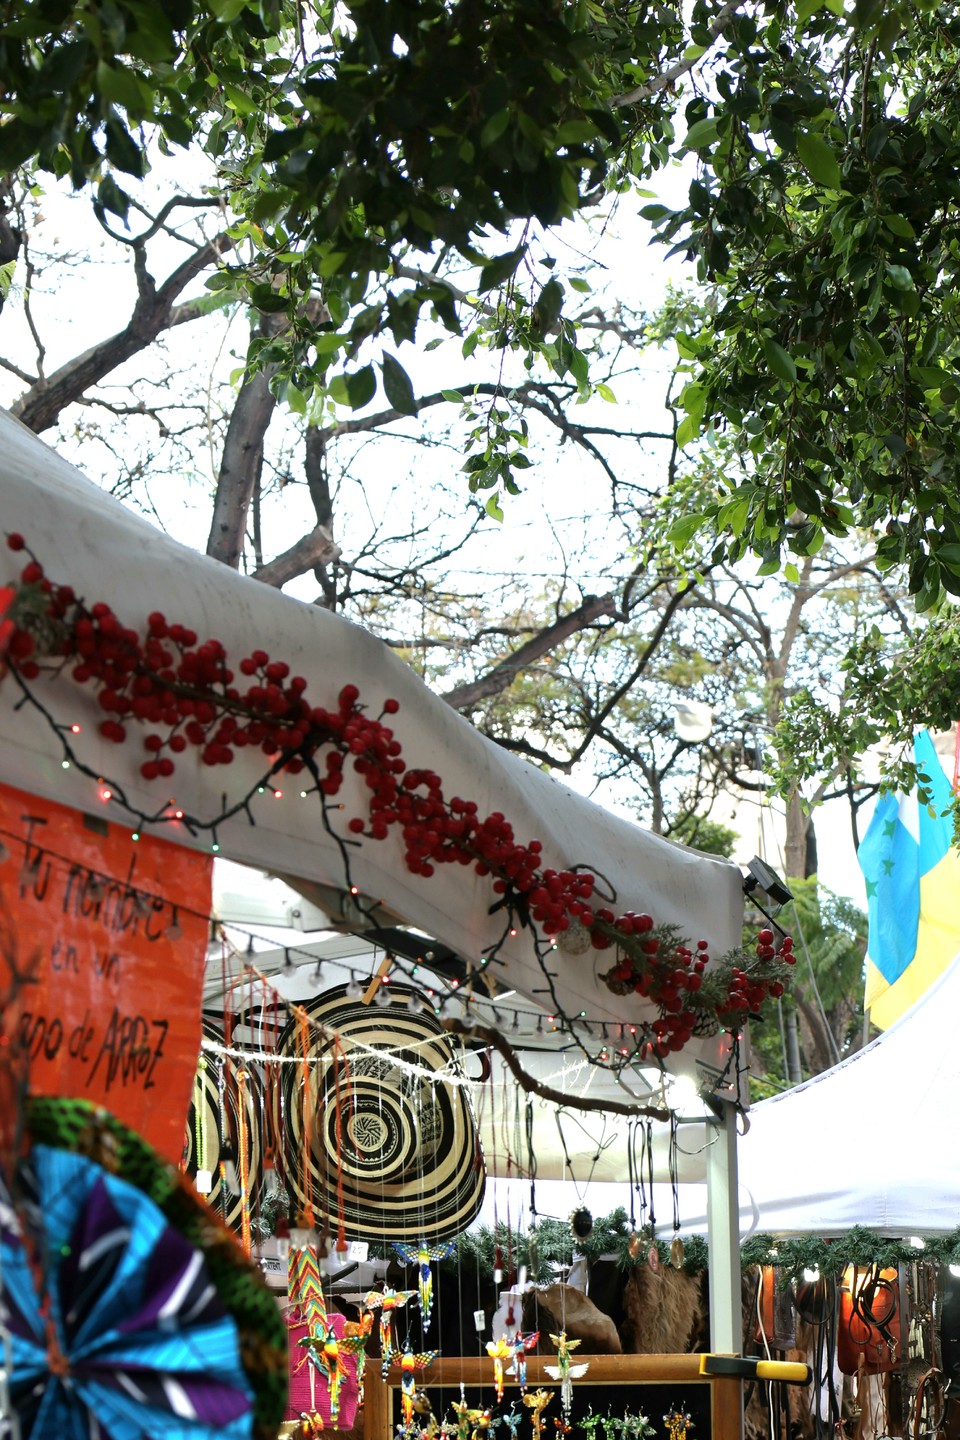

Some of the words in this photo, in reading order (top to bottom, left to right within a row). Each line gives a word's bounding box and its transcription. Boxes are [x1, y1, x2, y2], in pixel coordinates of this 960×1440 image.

[20, 815, 52, 901] Tu
[63, 852, 164, 942] nombre
[52, 939, 79, 974] en
[69, 1009, 95, 1063] de
